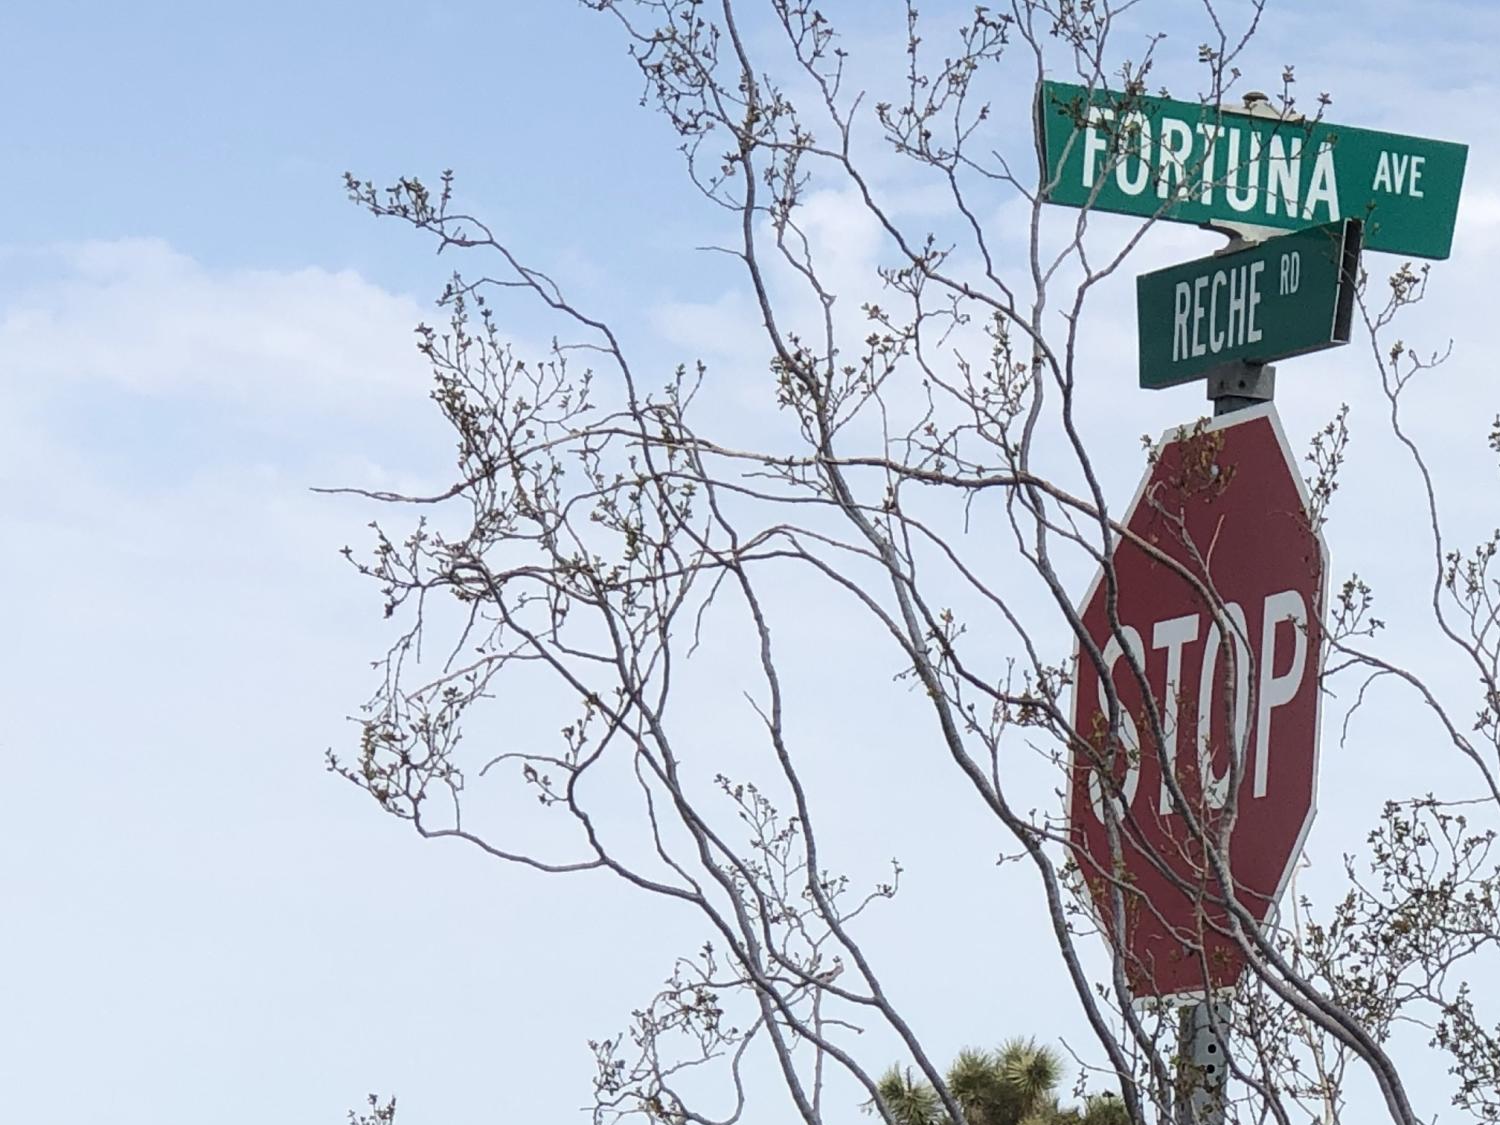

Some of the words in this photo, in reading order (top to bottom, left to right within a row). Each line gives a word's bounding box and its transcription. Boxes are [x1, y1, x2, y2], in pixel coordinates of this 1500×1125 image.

[1082, 105, 1341, 222] FORTUNA
[1372, 150, 1426, 198] AVE
[1172, 260, 1265, 362] RECHE
[1280, 250, 1300, 296] RD
[1087, 589, 1308, 826] STOP
